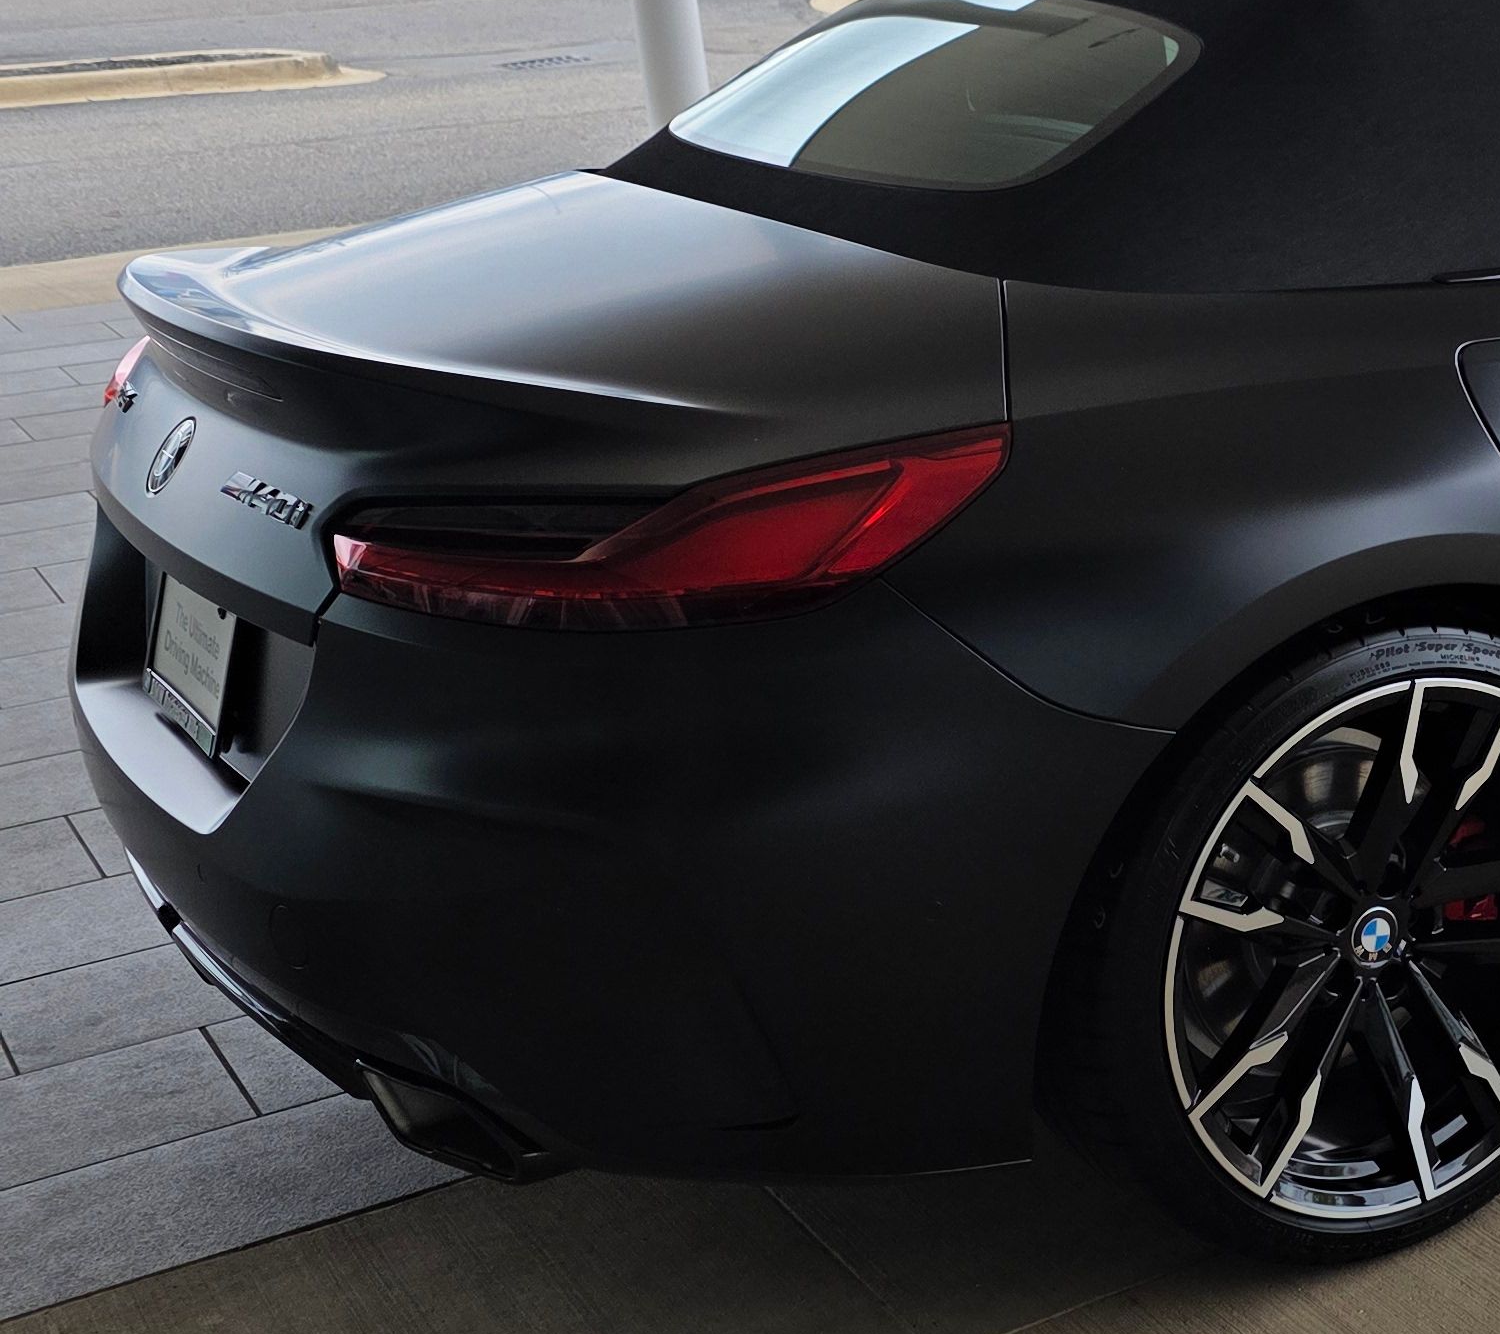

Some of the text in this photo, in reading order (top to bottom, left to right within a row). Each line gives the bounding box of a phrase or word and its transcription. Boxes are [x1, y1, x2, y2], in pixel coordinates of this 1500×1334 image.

[176, 600, 221, 661] The Ultimate
[1374, 643, 1410, 661] Pilot
[1416, 641, 1458, 654] Super
[164, 628, 221, 700] Driving Machine
